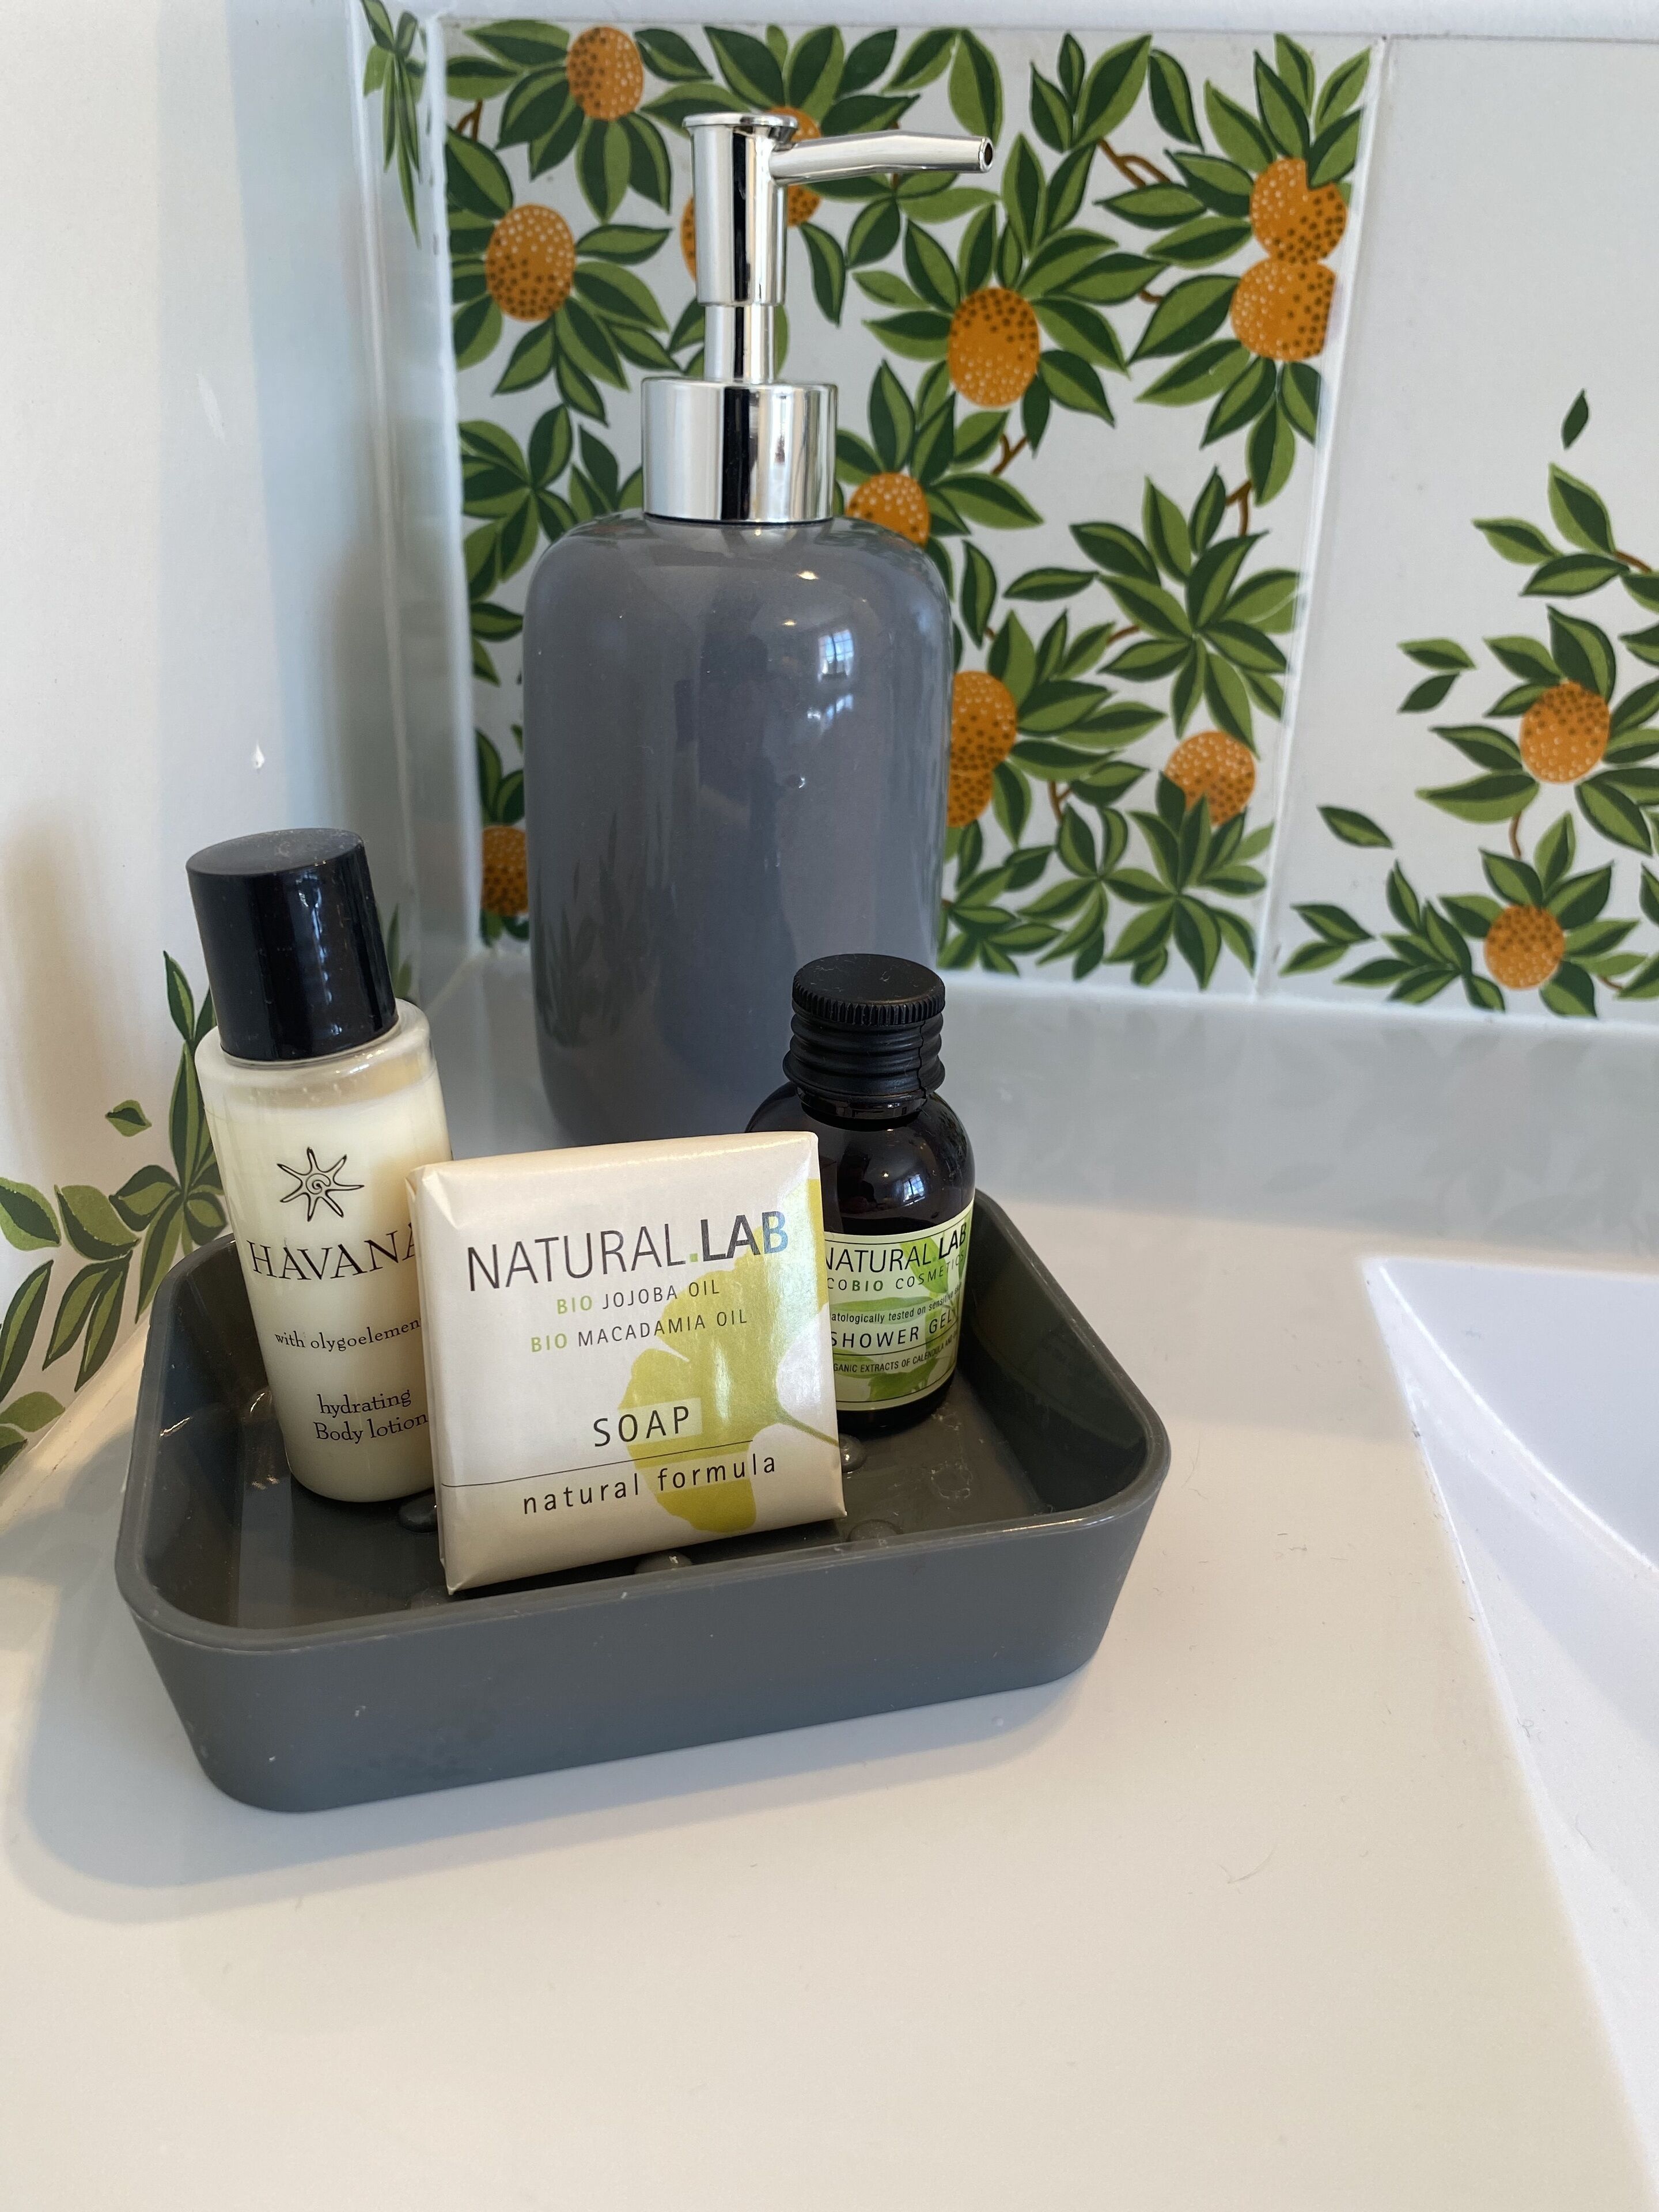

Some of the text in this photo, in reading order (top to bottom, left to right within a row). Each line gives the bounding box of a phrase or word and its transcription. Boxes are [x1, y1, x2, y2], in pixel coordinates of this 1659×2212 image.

[827, 1249, 964, 1292] COBIO COSMETICS
[556, 1279, 720, 1314] BIO JOJOBA OIL
[531, 1309, 748, 1353] BIO MACADAMIA OIL
[830, 1312, 885, 1325] atologically
[888, 1307, 915, 1321] tested
[916, 1306, 926, 1316] on
[831, 1309, 952, 1349] SHOWER GEL
[274, 1318, 421, 1352] with olygoelemen
[834, 1363, 857, 1373] GANIC
[860, 1361, 899, 1373] EXTRACTS
[901, 1357, 911, 1368] OF
[912, 1342, 944, 1365] CALENDULA
[317, 1389, 412, 1419] hydrating
[313, 1413, 429, 1445] Body lotion
[593, 1406, 690, 1447] SOAP
[523, 1453, 775, 1514] natural formula
